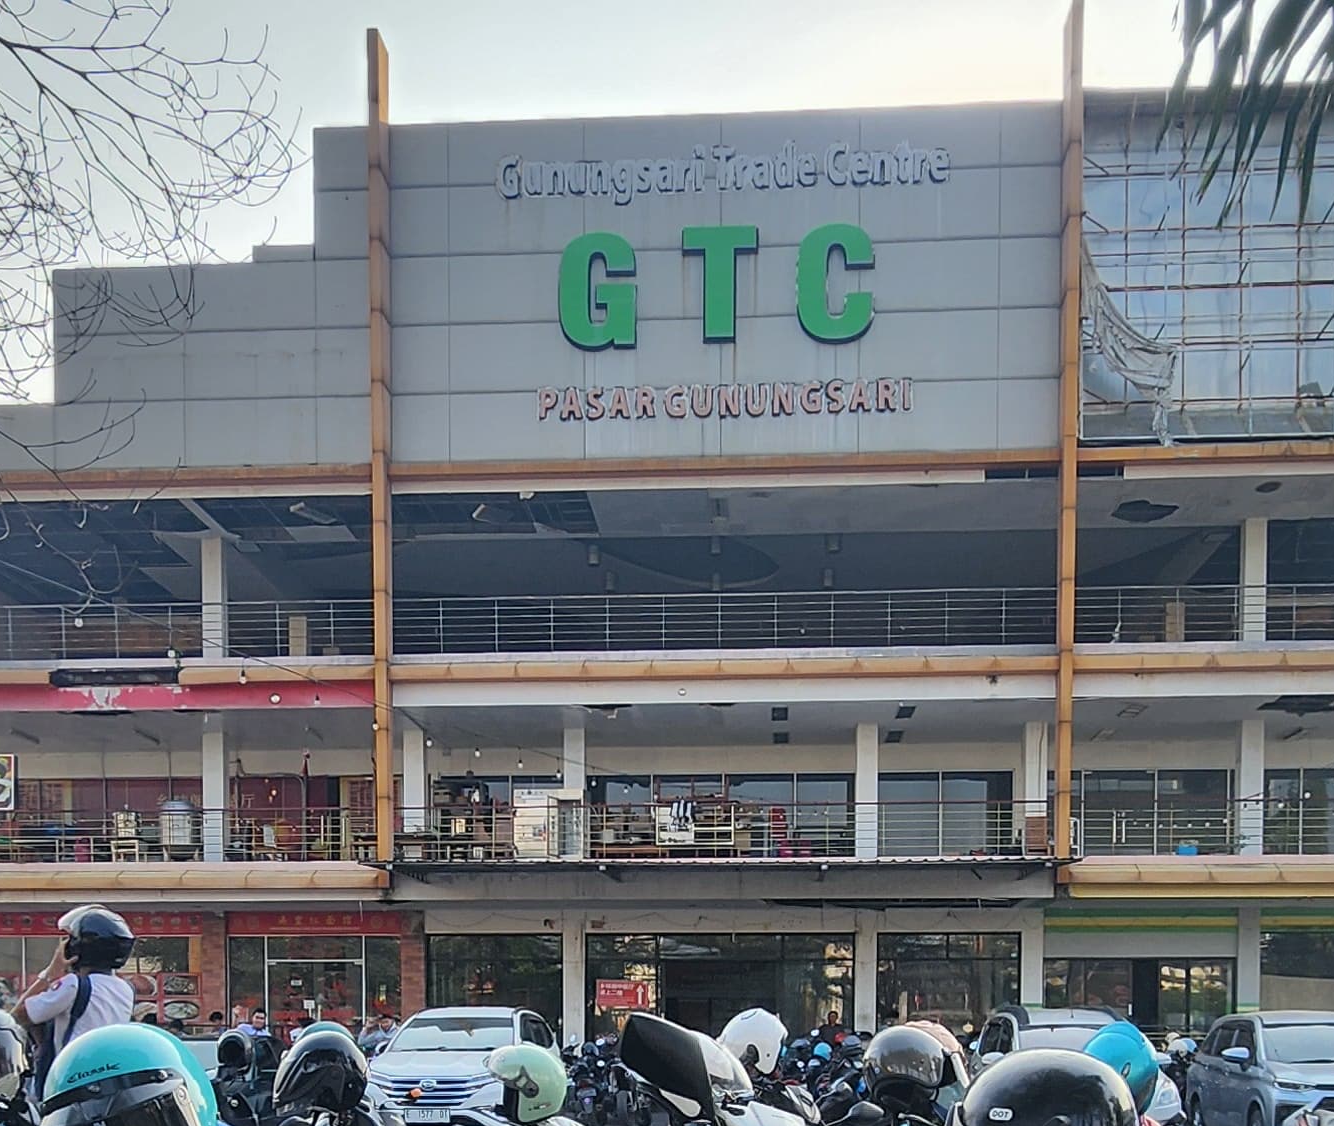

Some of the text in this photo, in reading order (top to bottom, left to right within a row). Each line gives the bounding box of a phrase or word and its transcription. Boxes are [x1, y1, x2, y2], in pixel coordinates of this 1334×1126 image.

[496, 141, 951, 205] Gunungsari Trade Centre
[558, 223, 875, 351] GTC
[537, 376, 915, 421] PASAR GUNUNGSARI
[992, 1110, 1010, 1119] DOT
